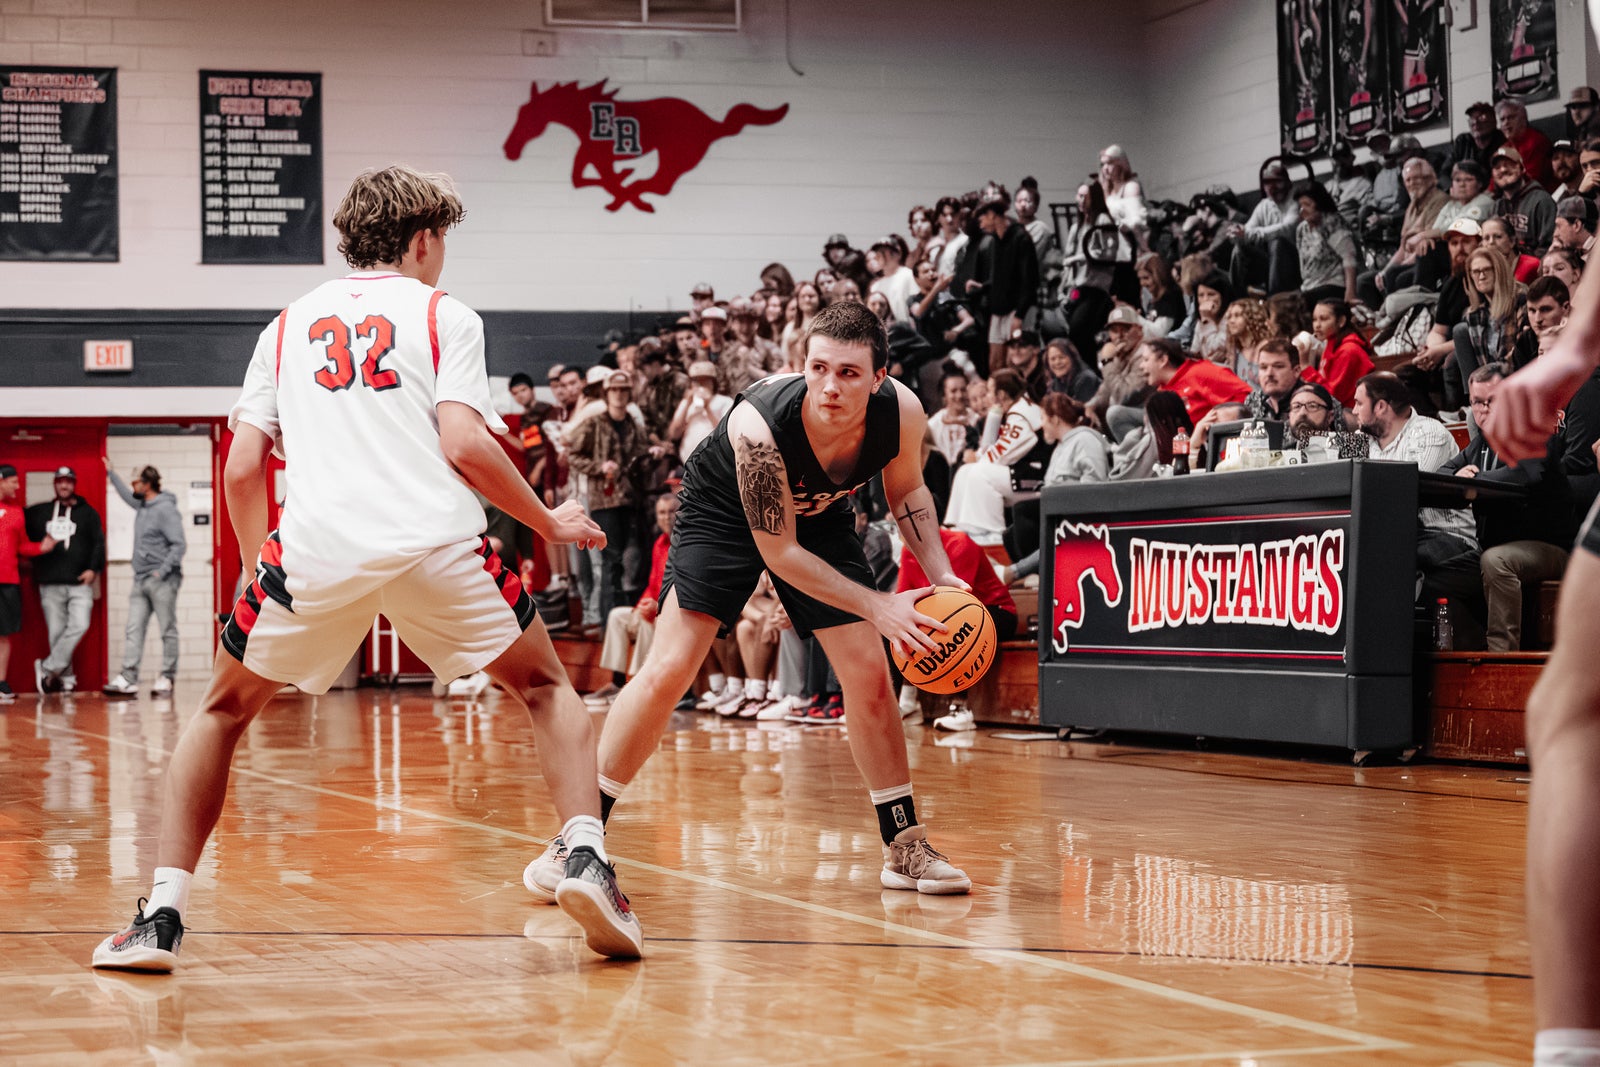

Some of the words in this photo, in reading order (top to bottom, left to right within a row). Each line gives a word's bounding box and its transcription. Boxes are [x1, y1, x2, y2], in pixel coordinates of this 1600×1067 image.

[95, 344, 124, 366] EXIT
[308, 314, 402, 393] 32
[1128, 528, 1344, 635] MUSTANGS
[914, 622, 974, 675] Wilson
[953, 653, 985, 688] EVO
